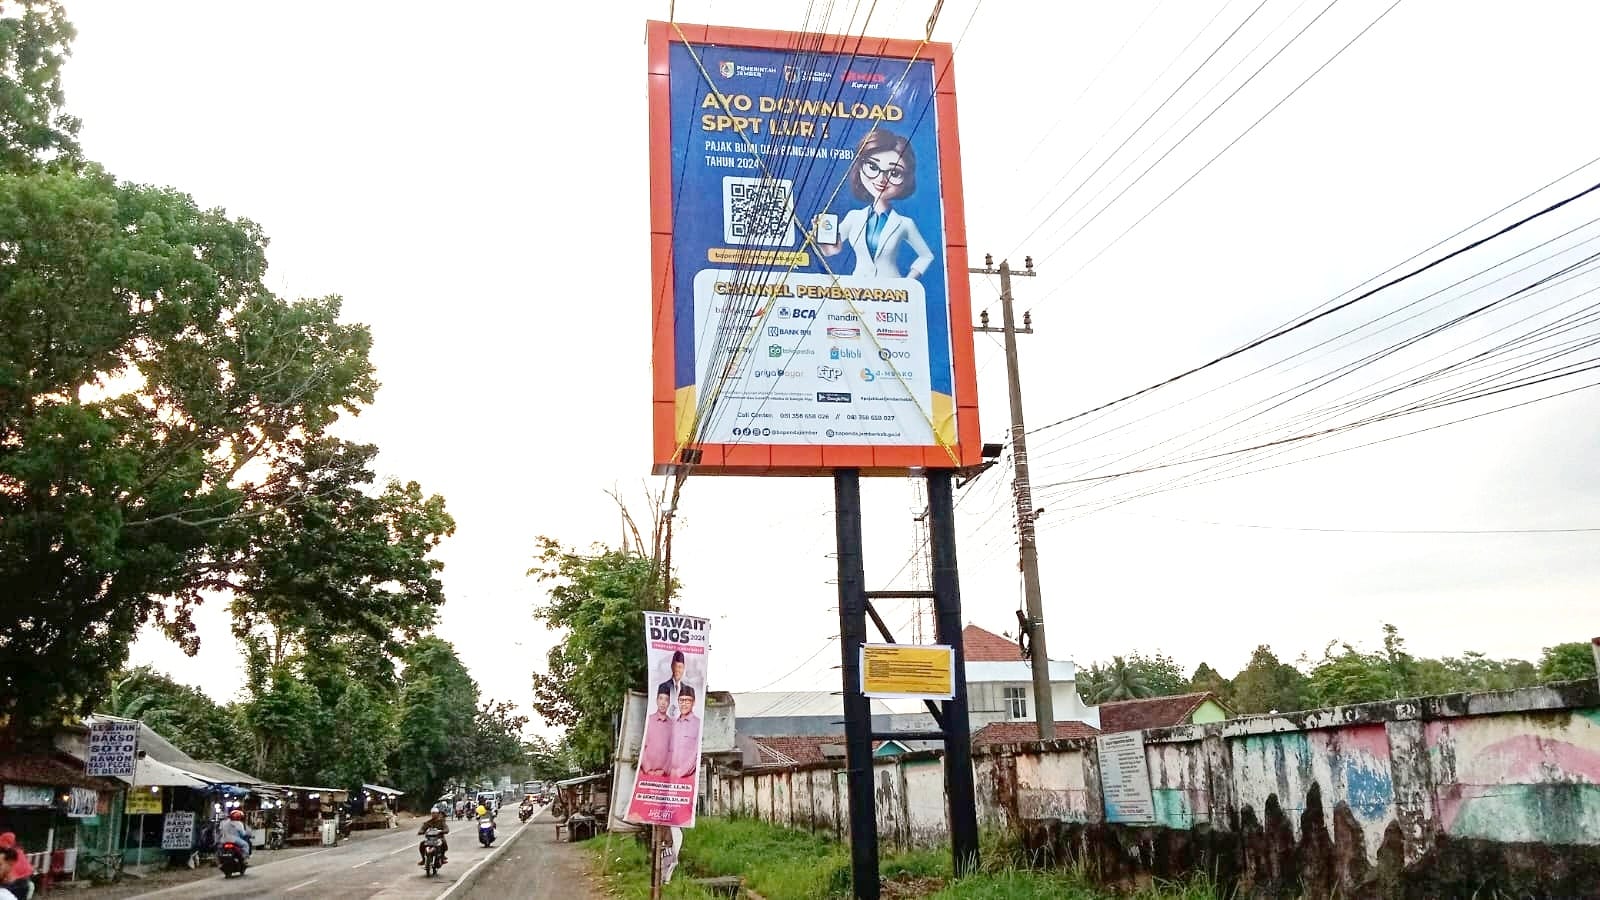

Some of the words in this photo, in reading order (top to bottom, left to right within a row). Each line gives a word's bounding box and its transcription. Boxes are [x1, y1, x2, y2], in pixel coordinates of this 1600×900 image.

[736, 65, 777, 74] PEMERINTAH
[702, 92, 752, 111] AYO
[759, 96, 903, 121] DOWNLOAD
[701, 114, 762, 134] SPPT
[705, 141, 732, 151] PAJAK
[735, 142, 757, 153] BUMI
[830, 149, 854, 160] (PBB)
[705, 156, 735, 168] TAHUN
[737, 158, 759, 169] 2024
[713, 281, 794, 298] CHANNEL
[796, 285, 909, 302] PEMBAYARAN
[792, 308, 817, 319] BCA
[886, 312, 908, 323] BNI
[779, 328, 798, 336] BANK
[840, 348, 862, 359] blibli
[654, 615, 706, 631] FAWAIT
[650, 627, 690, 644] DJOS
[690, 633, 705, 641] 2024
[92, 734, 134, 742] BAKSO
